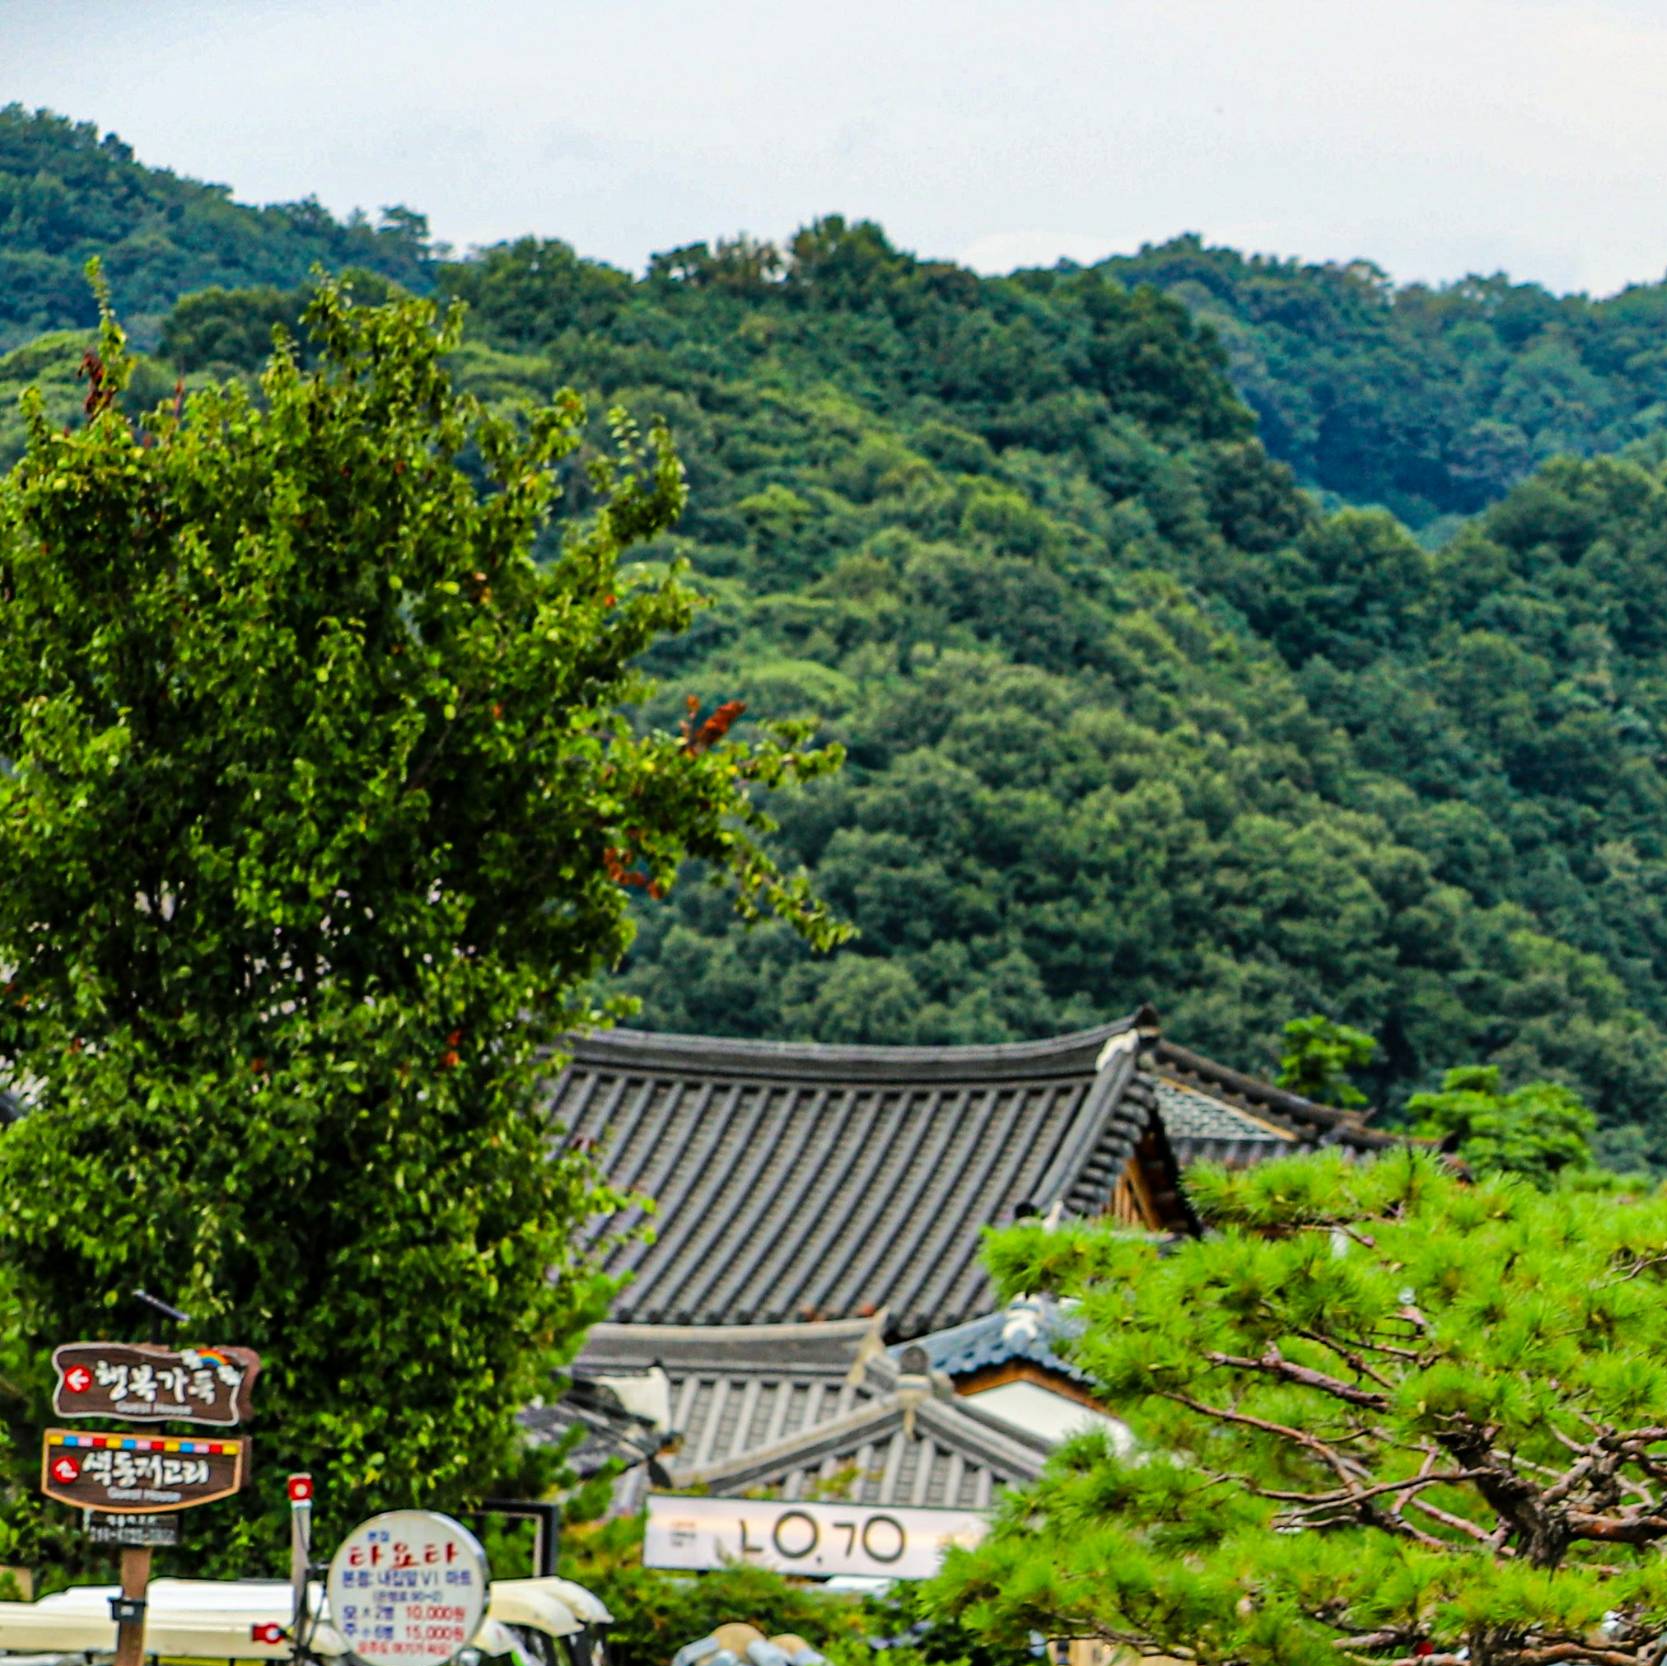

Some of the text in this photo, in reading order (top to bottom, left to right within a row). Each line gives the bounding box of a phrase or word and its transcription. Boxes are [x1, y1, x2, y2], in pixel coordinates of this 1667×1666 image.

[95, 1360, 215, 1404] 행복가득
[82, 1450, 209, 1488] 색동저고리
[349, 1542, 459, 1569] 타요타
